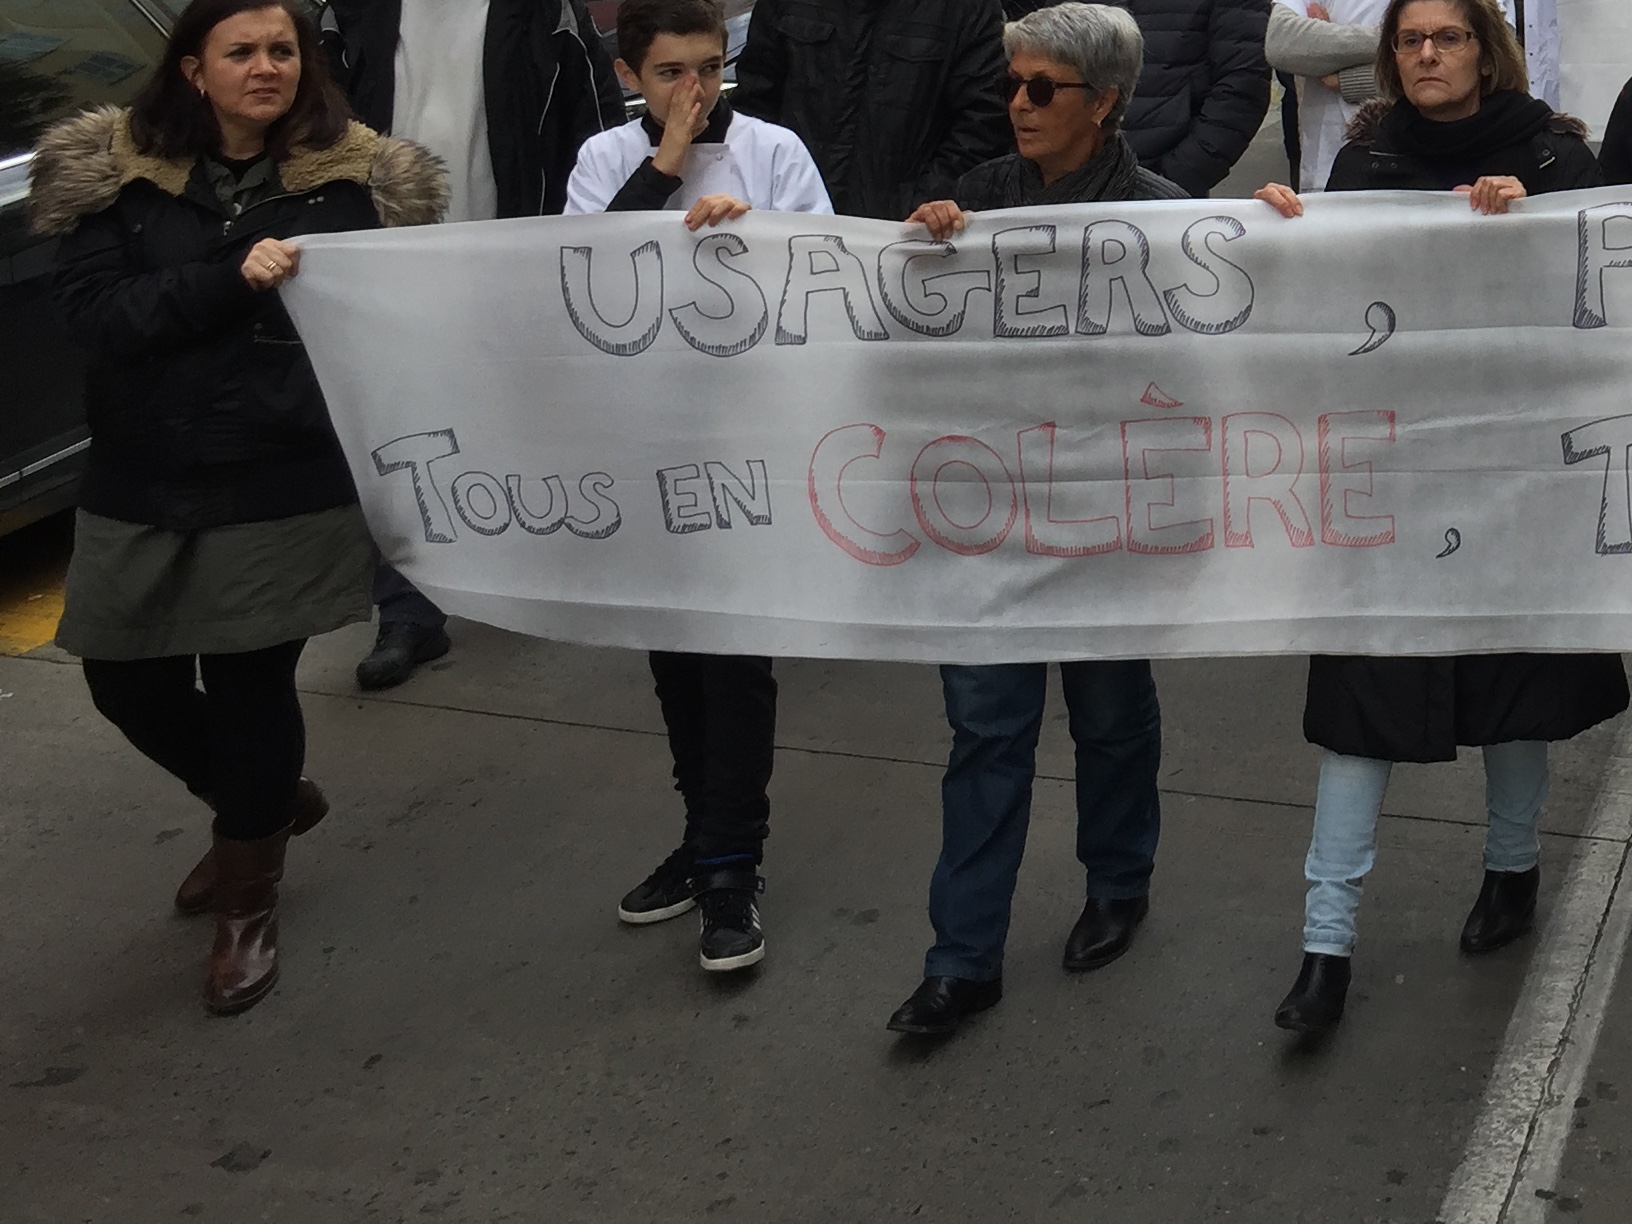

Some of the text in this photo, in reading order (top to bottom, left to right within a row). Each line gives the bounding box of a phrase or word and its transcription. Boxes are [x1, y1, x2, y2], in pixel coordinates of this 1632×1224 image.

[559, 215, 1255, 358] USAGERS
[656, 459, 772, 534] EN
[808, 381, 1396, 566] COLÈRE
